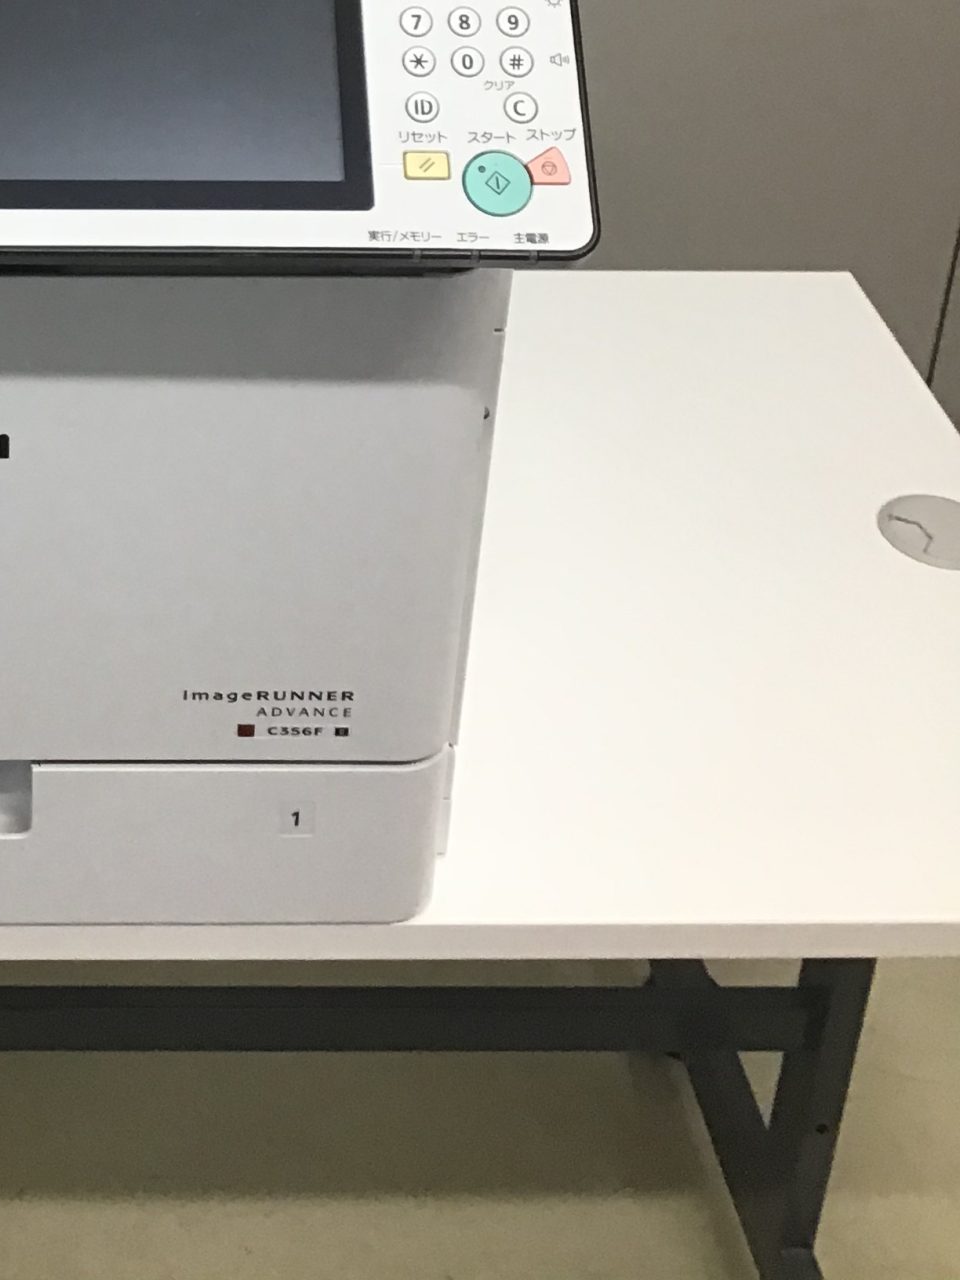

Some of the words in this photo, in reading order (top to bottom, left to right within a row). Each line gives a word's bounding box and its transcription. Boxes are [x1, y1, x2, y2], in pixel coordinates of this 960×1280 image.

[410, 14, 422, 30] 7
[458, 14, 471, 30] 8
[507, 14, 519, 30] 9
[461, 54, 474, 70] 0
[509, 54, 524, 70] #
[484, 80, 515, 91] クリア
[414, 99, 433, 116] ID
[513, 100, 527, 116] C
[399, 131, 446, 143] リセット
[468, 132, 516, 143] スタート
[526, 128, 576, 141] ストップ
[368, 231, 440, 241] 実行/メモリー
[457, 232, 489, 243] エラー
[514, 233, 548, 244] 主電源
[256, 707, 351, 718] ADVANCE
[267, 727, 322, 736] C356F
[291, 810, 301, 827] 1
